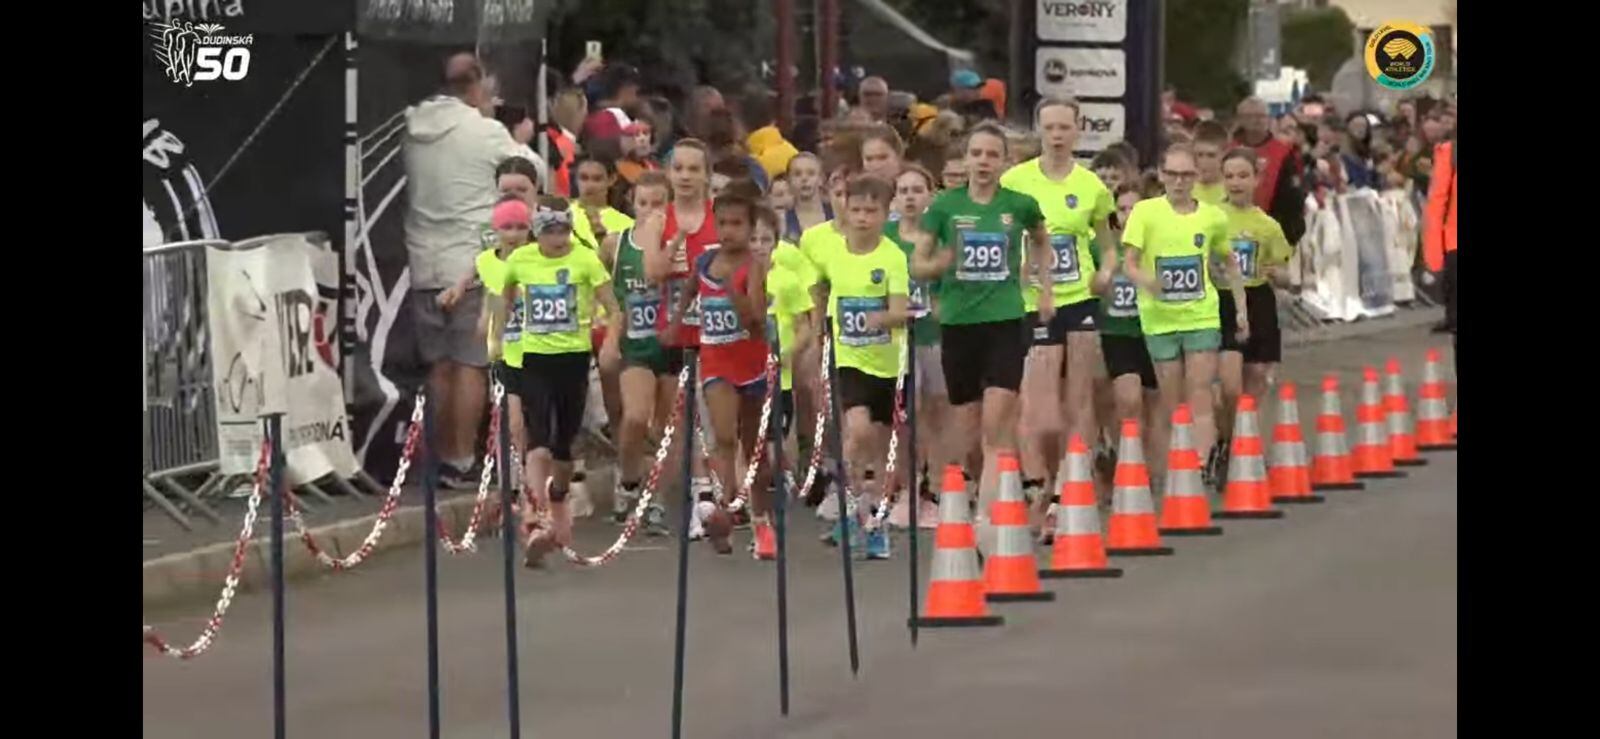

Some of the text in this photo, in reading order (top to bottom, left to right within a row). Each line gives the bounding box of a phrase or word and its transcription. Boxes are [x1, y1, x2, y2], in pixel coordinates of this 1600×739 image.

[963, 245, 1002, 268] 299
[1113, 286, 1136, 307] 32
[531, 298, 568, 320] 328
[632, 305, 658, 327] 30
[703, 310, 738, 332] 330
[843, 311, 870, 333] 30
